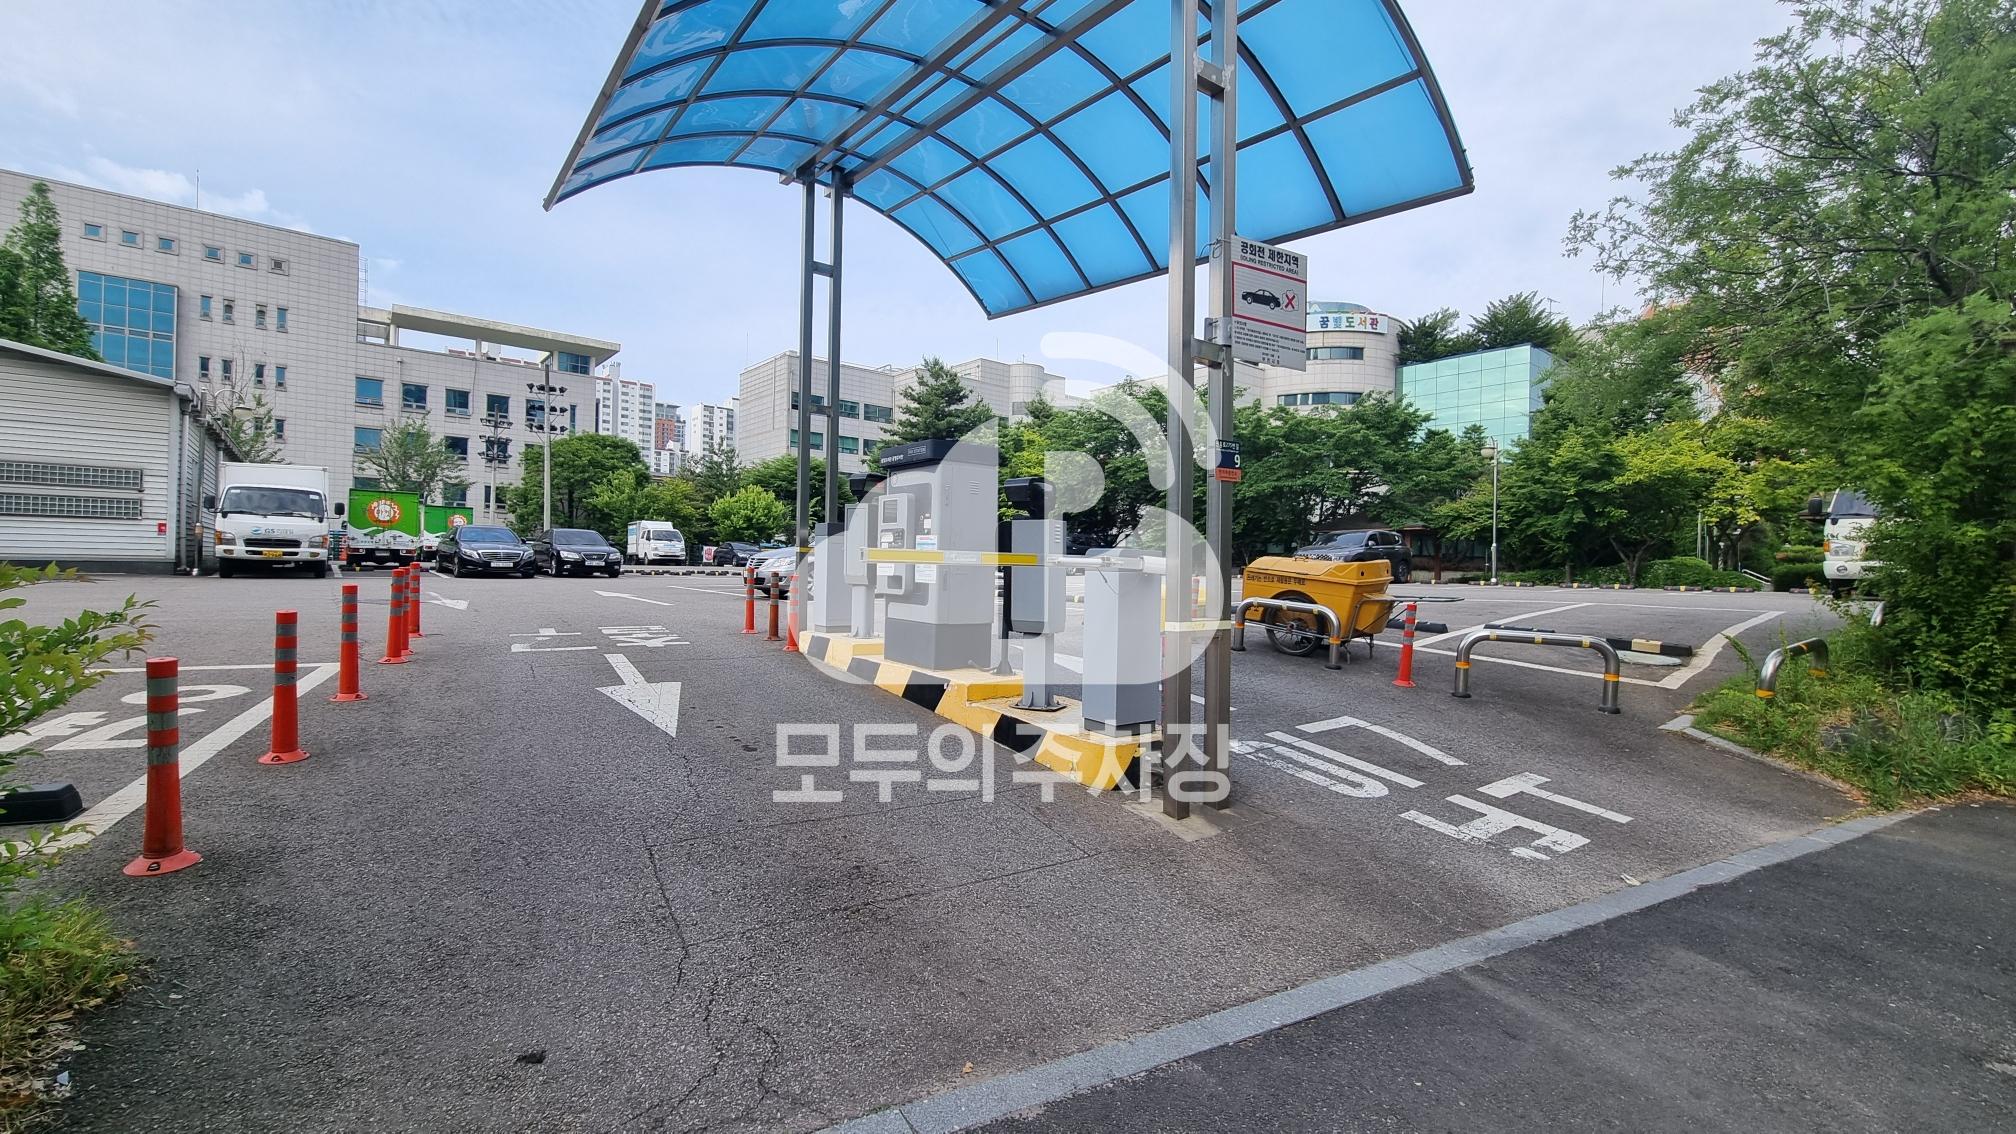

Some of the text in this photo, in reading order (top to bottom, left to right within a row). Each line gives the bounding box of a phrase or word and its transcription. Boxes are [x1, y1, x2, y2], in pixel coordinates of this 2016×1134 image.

[1240, 241, 1299, 268] 공회전 제한지역
[1258, 259, 1285, 272] RESTRICTED
[1319, 316, 1379, 330] 꿈빛도서관
[1234, 454, 1240, 468] 9
